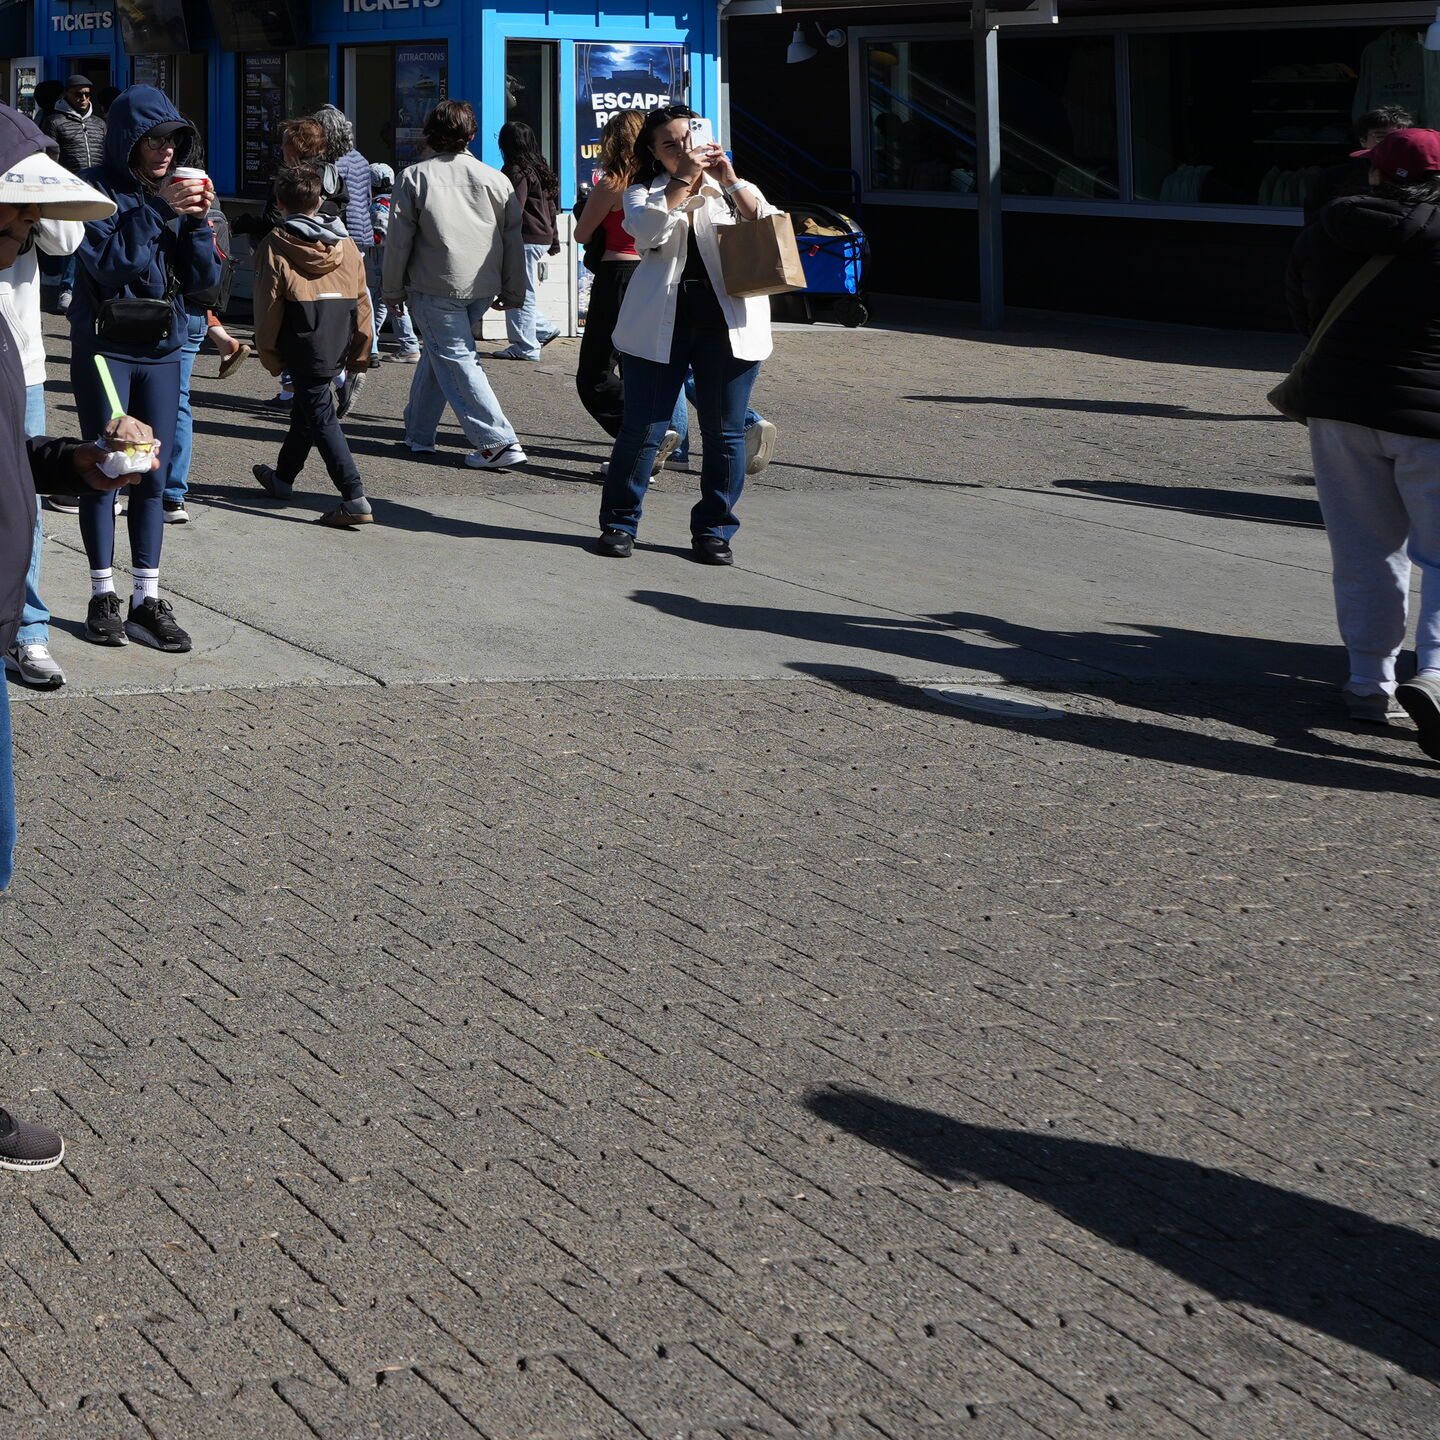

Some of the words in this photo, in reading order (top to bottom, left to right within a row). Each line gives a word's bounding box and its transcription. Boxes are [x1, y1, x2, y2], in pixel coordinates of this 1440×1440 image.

[51, 10, 113, 32] TICKETS
[398, 52, 446, 62] ATTRACTIONS
[591, 92, 671, 111] ESCAPE
